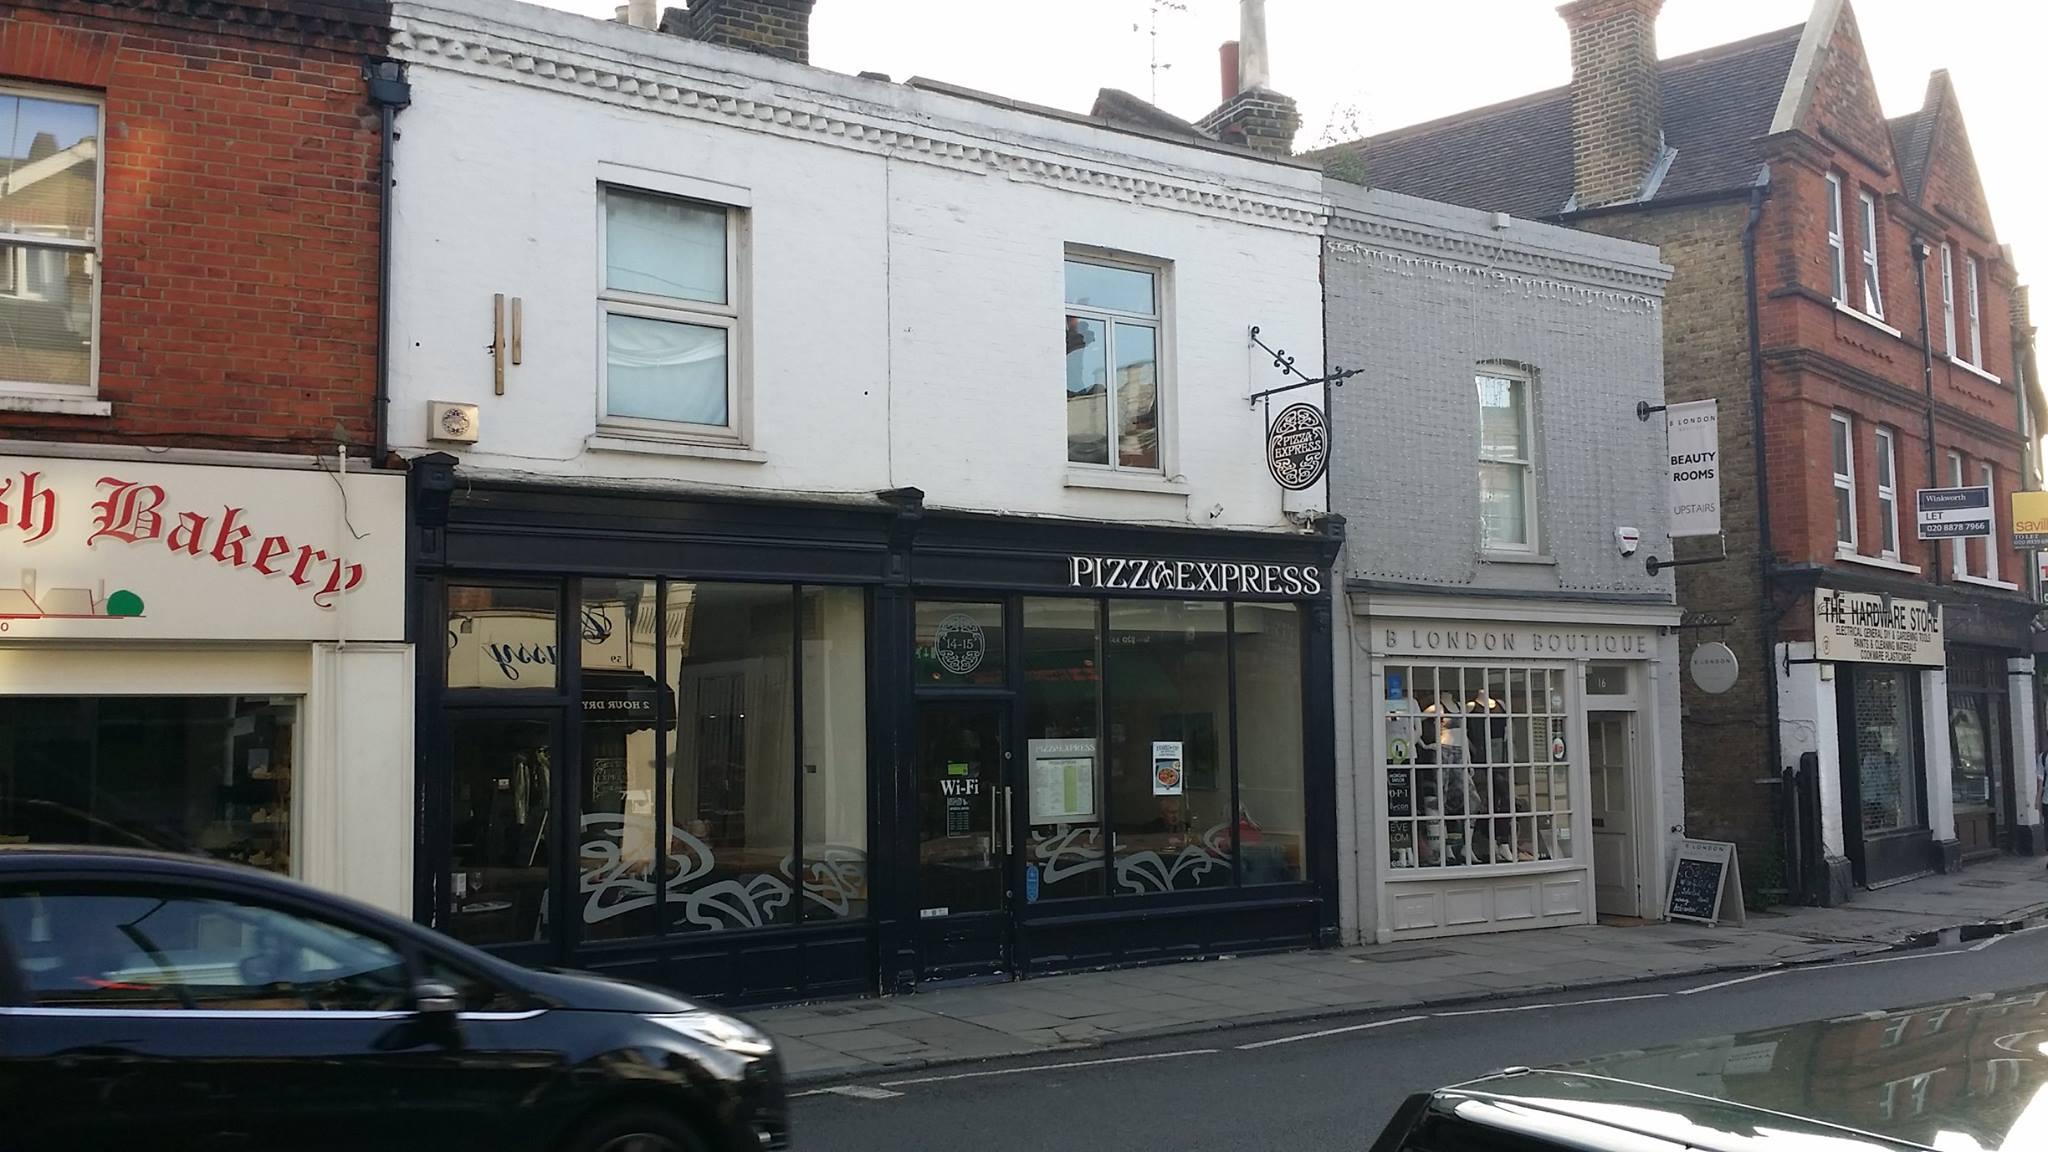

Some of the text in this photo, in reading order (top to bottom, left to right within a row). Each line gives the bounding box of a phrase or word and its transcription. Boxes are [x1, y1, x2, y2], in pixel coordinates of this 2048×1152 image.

[1678, 416, 1715, 425] LONDON
[1283, 432, 1312, 446] PIZZA
[1275, 440, 1321, 458] EXPRESS
[1671, 452, 1716, 465] BEAUTY
[1673, 469, 1714, 481] ROOMS
[1926, 493, 1966, 502] Winkworth
[1674, 503, 1716, 515] UPSTAIRS
[1926, 512, 1943, 520] LET
[1965, 522, 1985, 530] 7966
[87, 476, 364, 608] Bakery
[1823, 596, 1845, 624] THE
[1910, 607, 1938, 633] STORE
[1835, 625, 1862, 637] ELECTRICAL
[1863, 627, 1883, 639] GENERAL
[1896, 630, 1918, 642] GARDENING
[946, 639, 974, 649] 14-15
[1386, 629, 1646, 652] B LONDON BOUTIQUE
[1853, 637, 1869, 649] PAINTS
[1874, 639, 1896, 651] CLEANING
[1896, 641, 1917, 653] MATERIALS
[1598, 677, 1607, 688] 16
[941, 778, 979, 796] Wi-Fi
[1390, 823, 1409, 832] EVE
